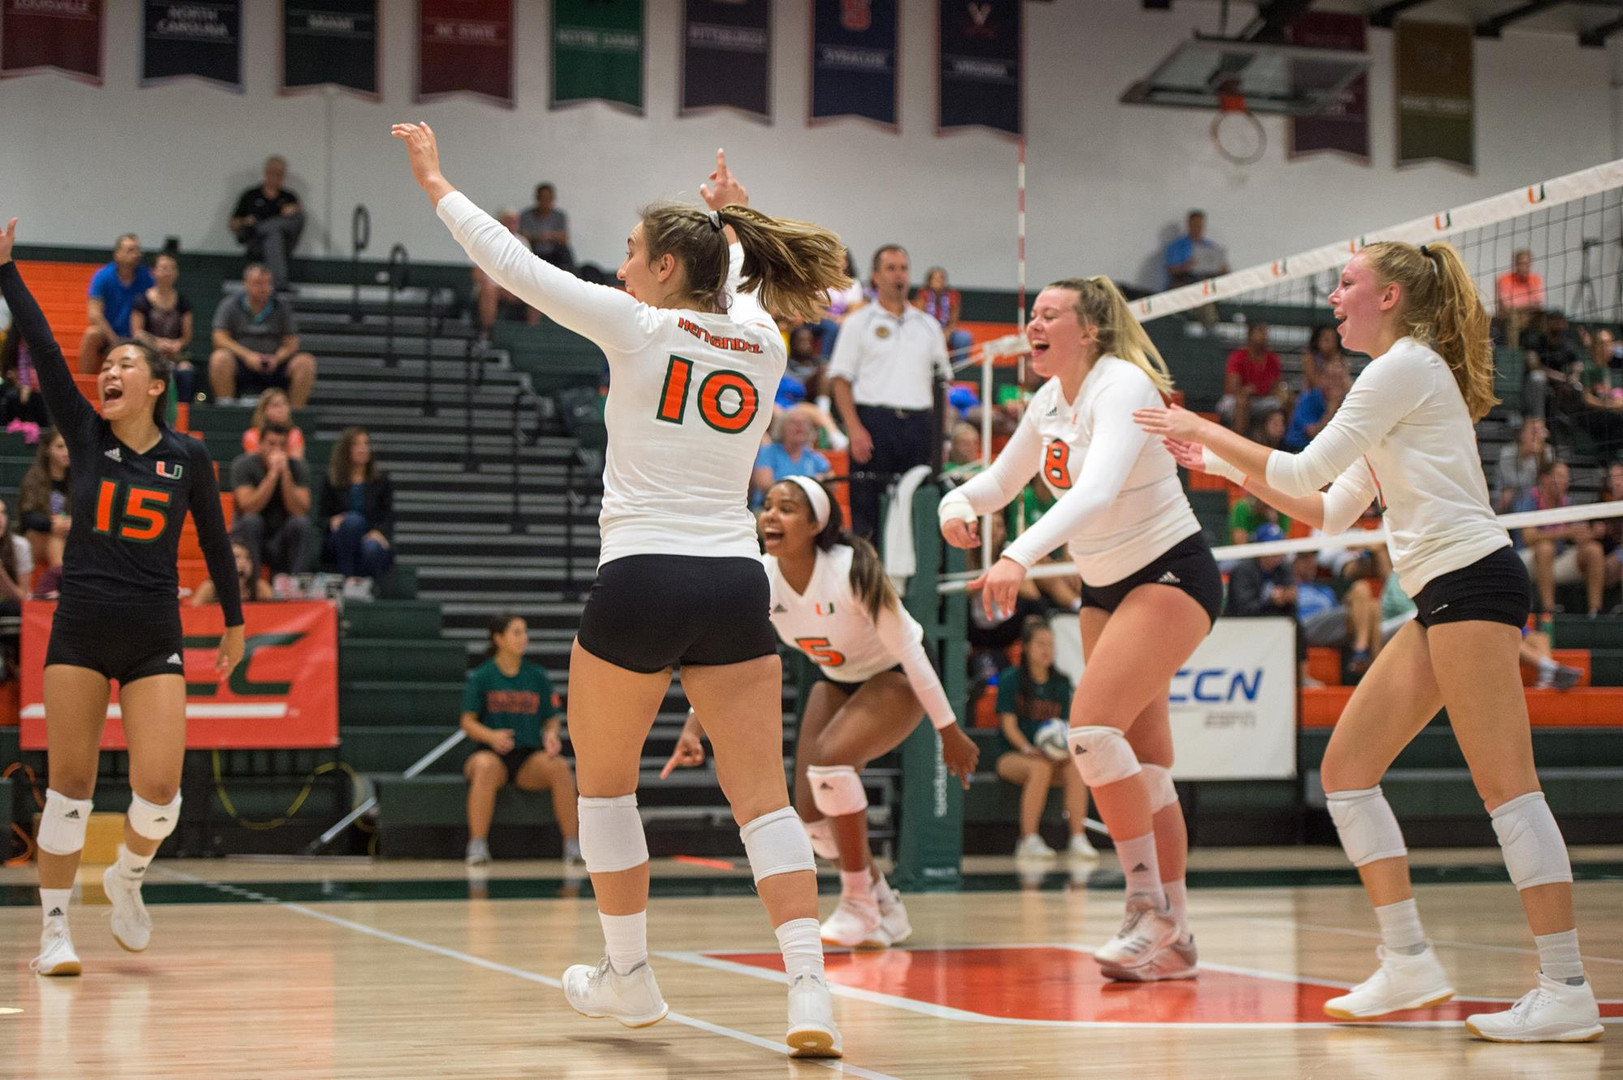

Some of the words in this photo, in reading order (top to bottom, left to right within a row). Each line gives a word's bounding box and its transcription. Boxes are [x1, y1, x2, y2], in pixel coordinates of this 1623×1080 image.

[656, 354, 759, 434] 10
[156, 460, 183, 480] U
[1044, 438, 1073, 490] 8
[93, 477, 173, 544] 15
[795, 637, 846, 668] 5
